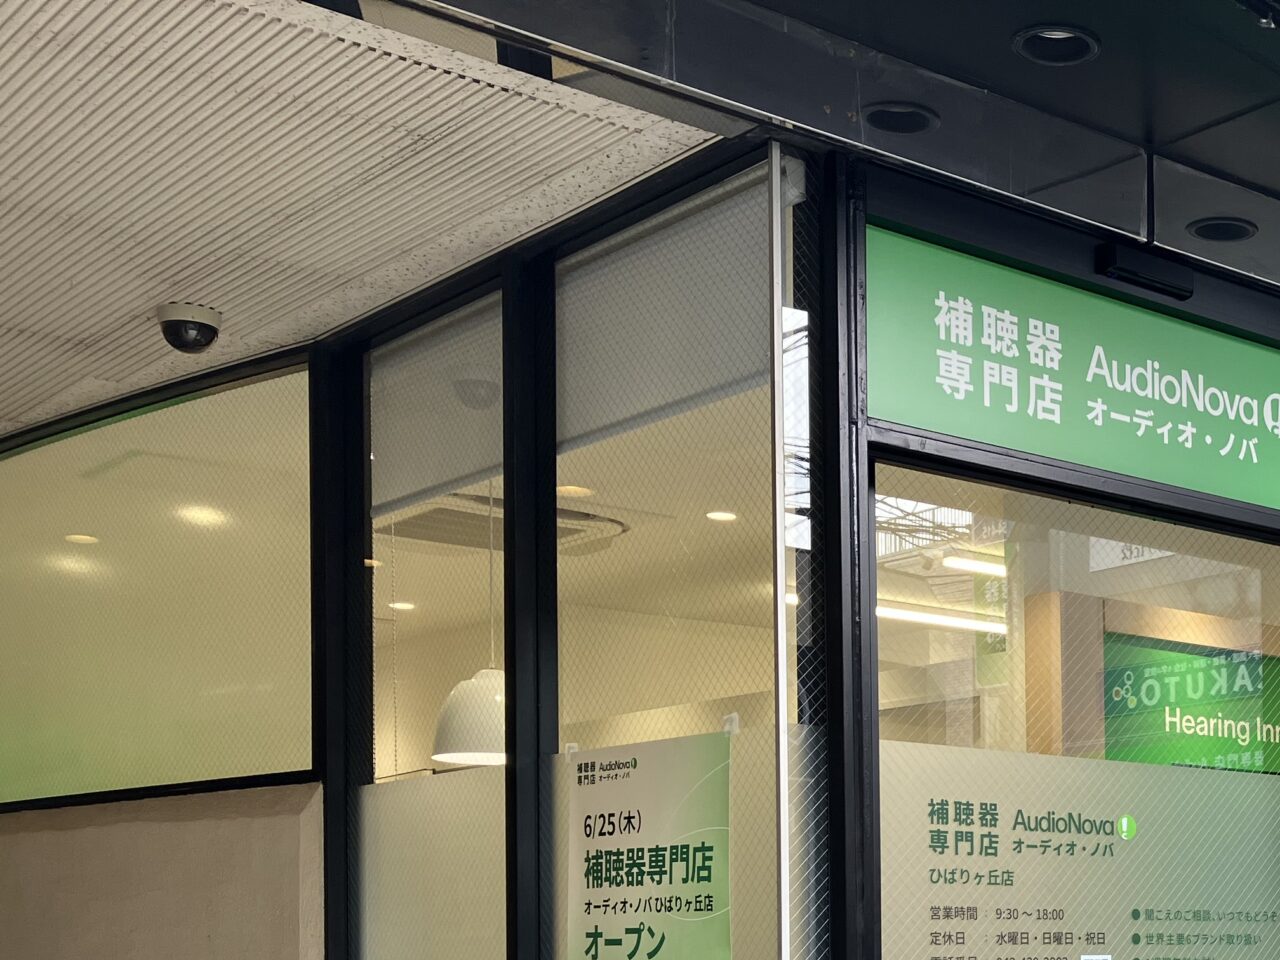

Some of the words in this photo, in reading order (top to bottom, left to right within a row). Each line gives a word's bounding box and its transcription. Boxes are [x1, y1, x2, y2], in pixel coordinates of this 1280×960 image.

[934, 290, 1063, 371] 補聴器
[935, 348, 1063, 425] 専門店
[1086, 345, 1258, 427] AudioNova
[1086, 399, 1259, 464] オーディオ・ノバ
[1165, 706, 1250, 746] Hearing
[928, 798, 999, 828] 補聴器
[1012, 809, 1115, 836] AudioNova
[928, 829, 999, 857] 専門店
[1012, 838, 1114, 857] オーディオ・ノバ
[584, 841, 714, 889] 補聴器専門店
[930, 906, 978, 921] 営業時間
[584, 921, 665, 960] オープン
[930, 931, 965, 946] 定休日
